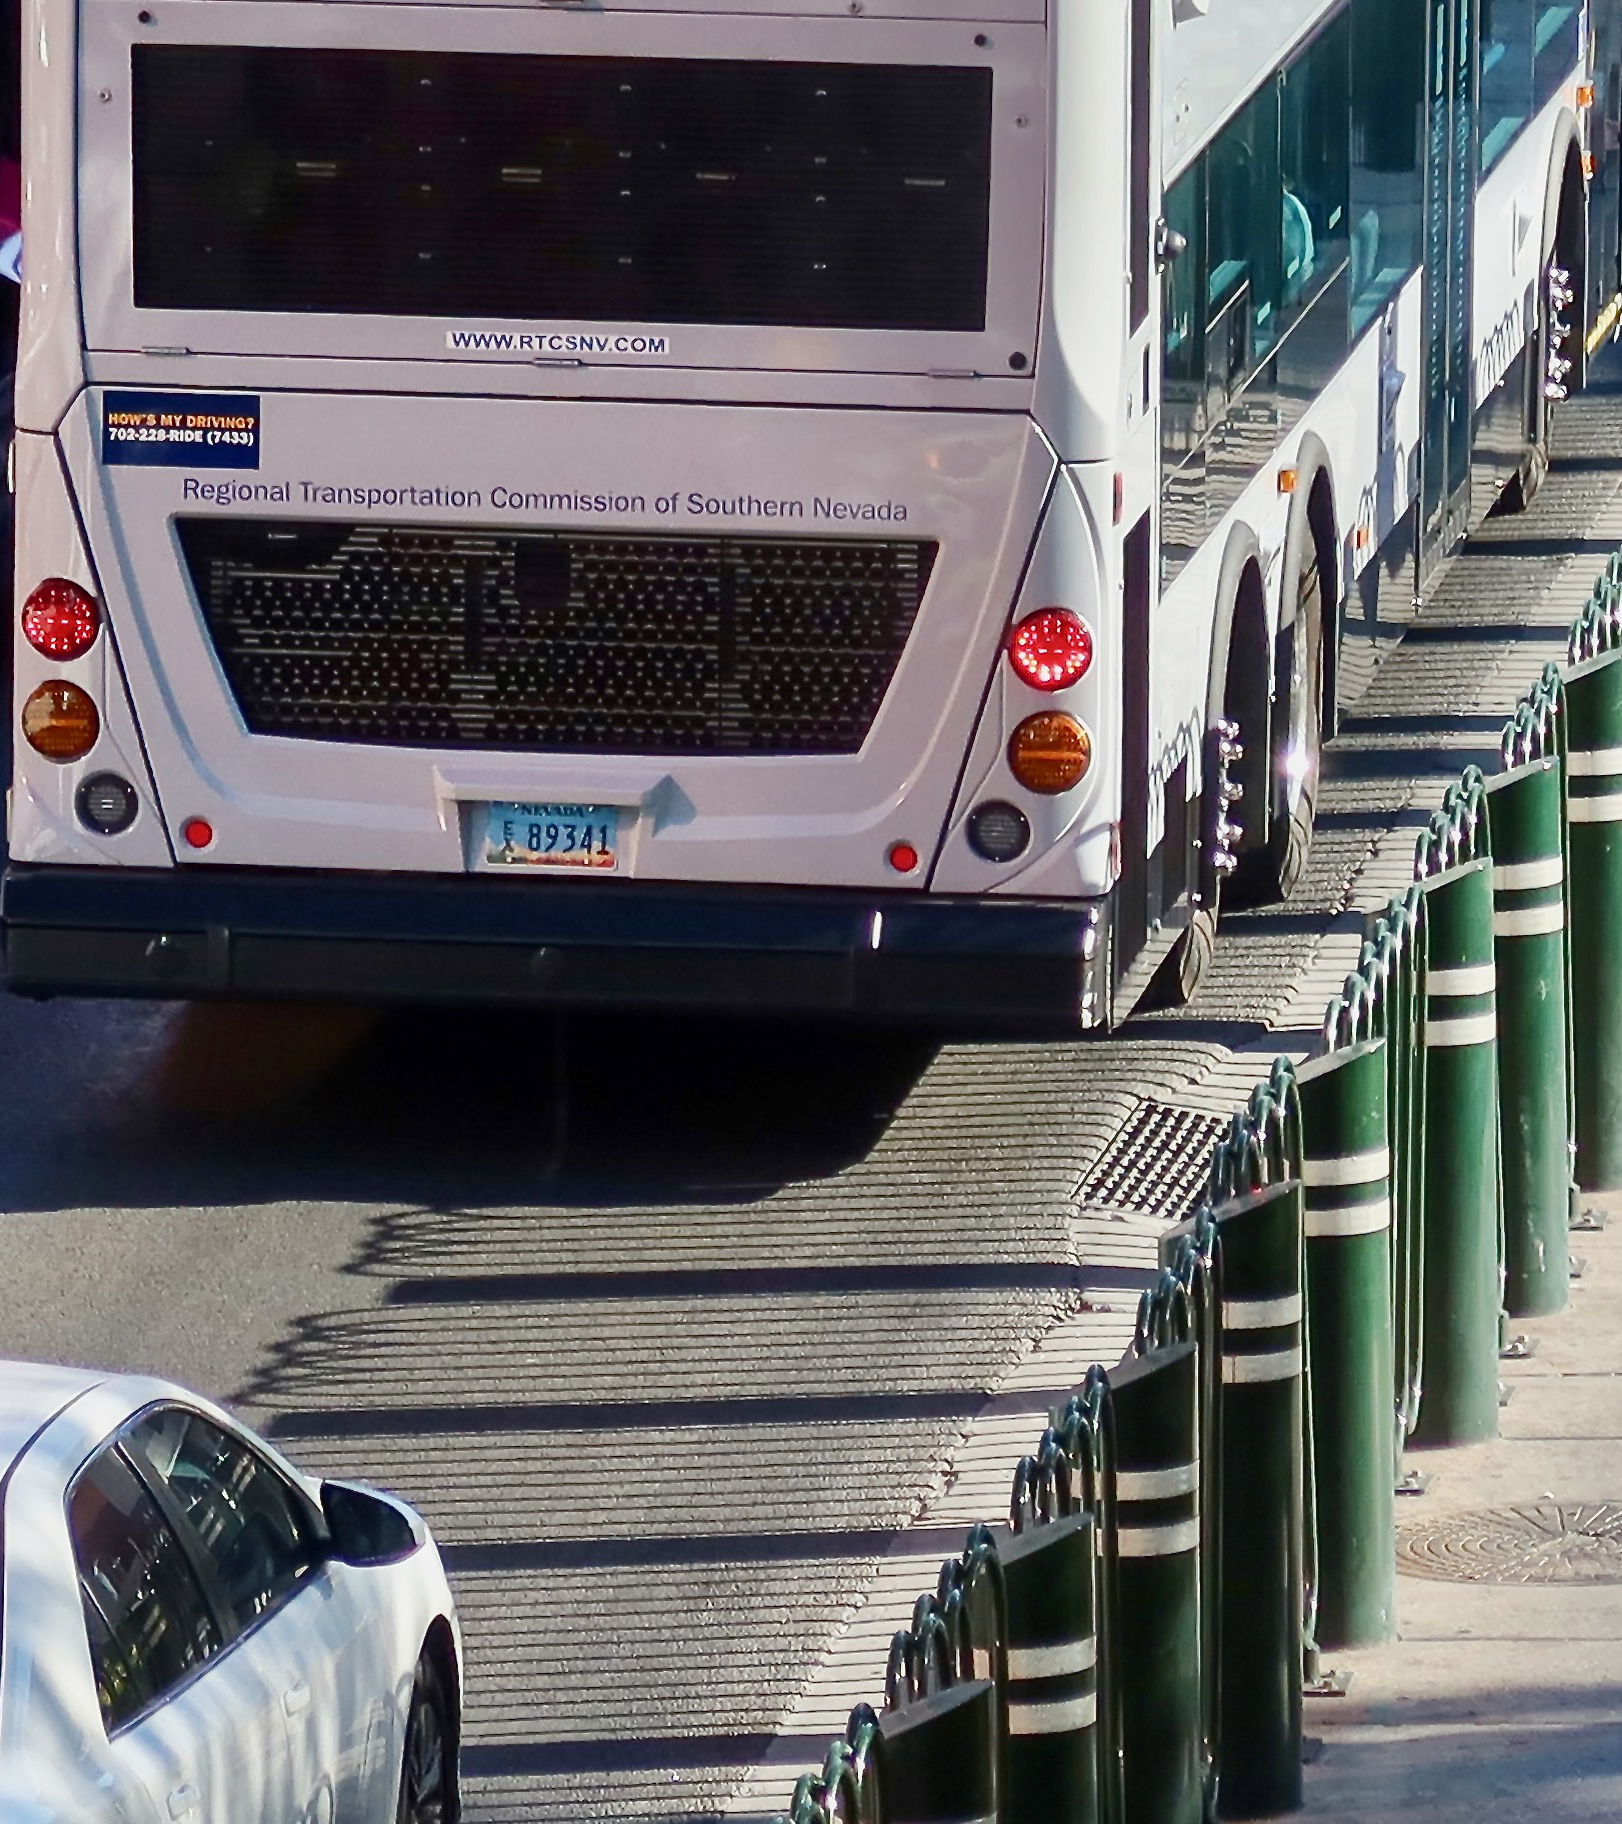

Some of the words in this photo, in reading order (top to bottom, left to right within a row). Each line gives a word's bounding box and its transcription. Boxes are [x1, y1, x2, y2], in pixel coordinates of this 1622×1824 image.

[452, 332, 666, 353] WWW.RTCSNV.COM
[108, 413, 157, 427] HOW'S
[159, 414, 183, 427] MY
[186, 415, 255, 430] DRIVING?
[108, 427, 204, 443] 702-228-RIDE
[206, 431, 254, 447] (7433)
[182, 478, 290, 506] Regional
[299, 481, 481, 510] Transportation
[490, 486, 646, 514] Commission
[654, 491, 682, 514] of
[686, 492, 804, 518] Southern
[812, 496, 908, 522] Nevada
[528, 822, 610, 856] 89341
